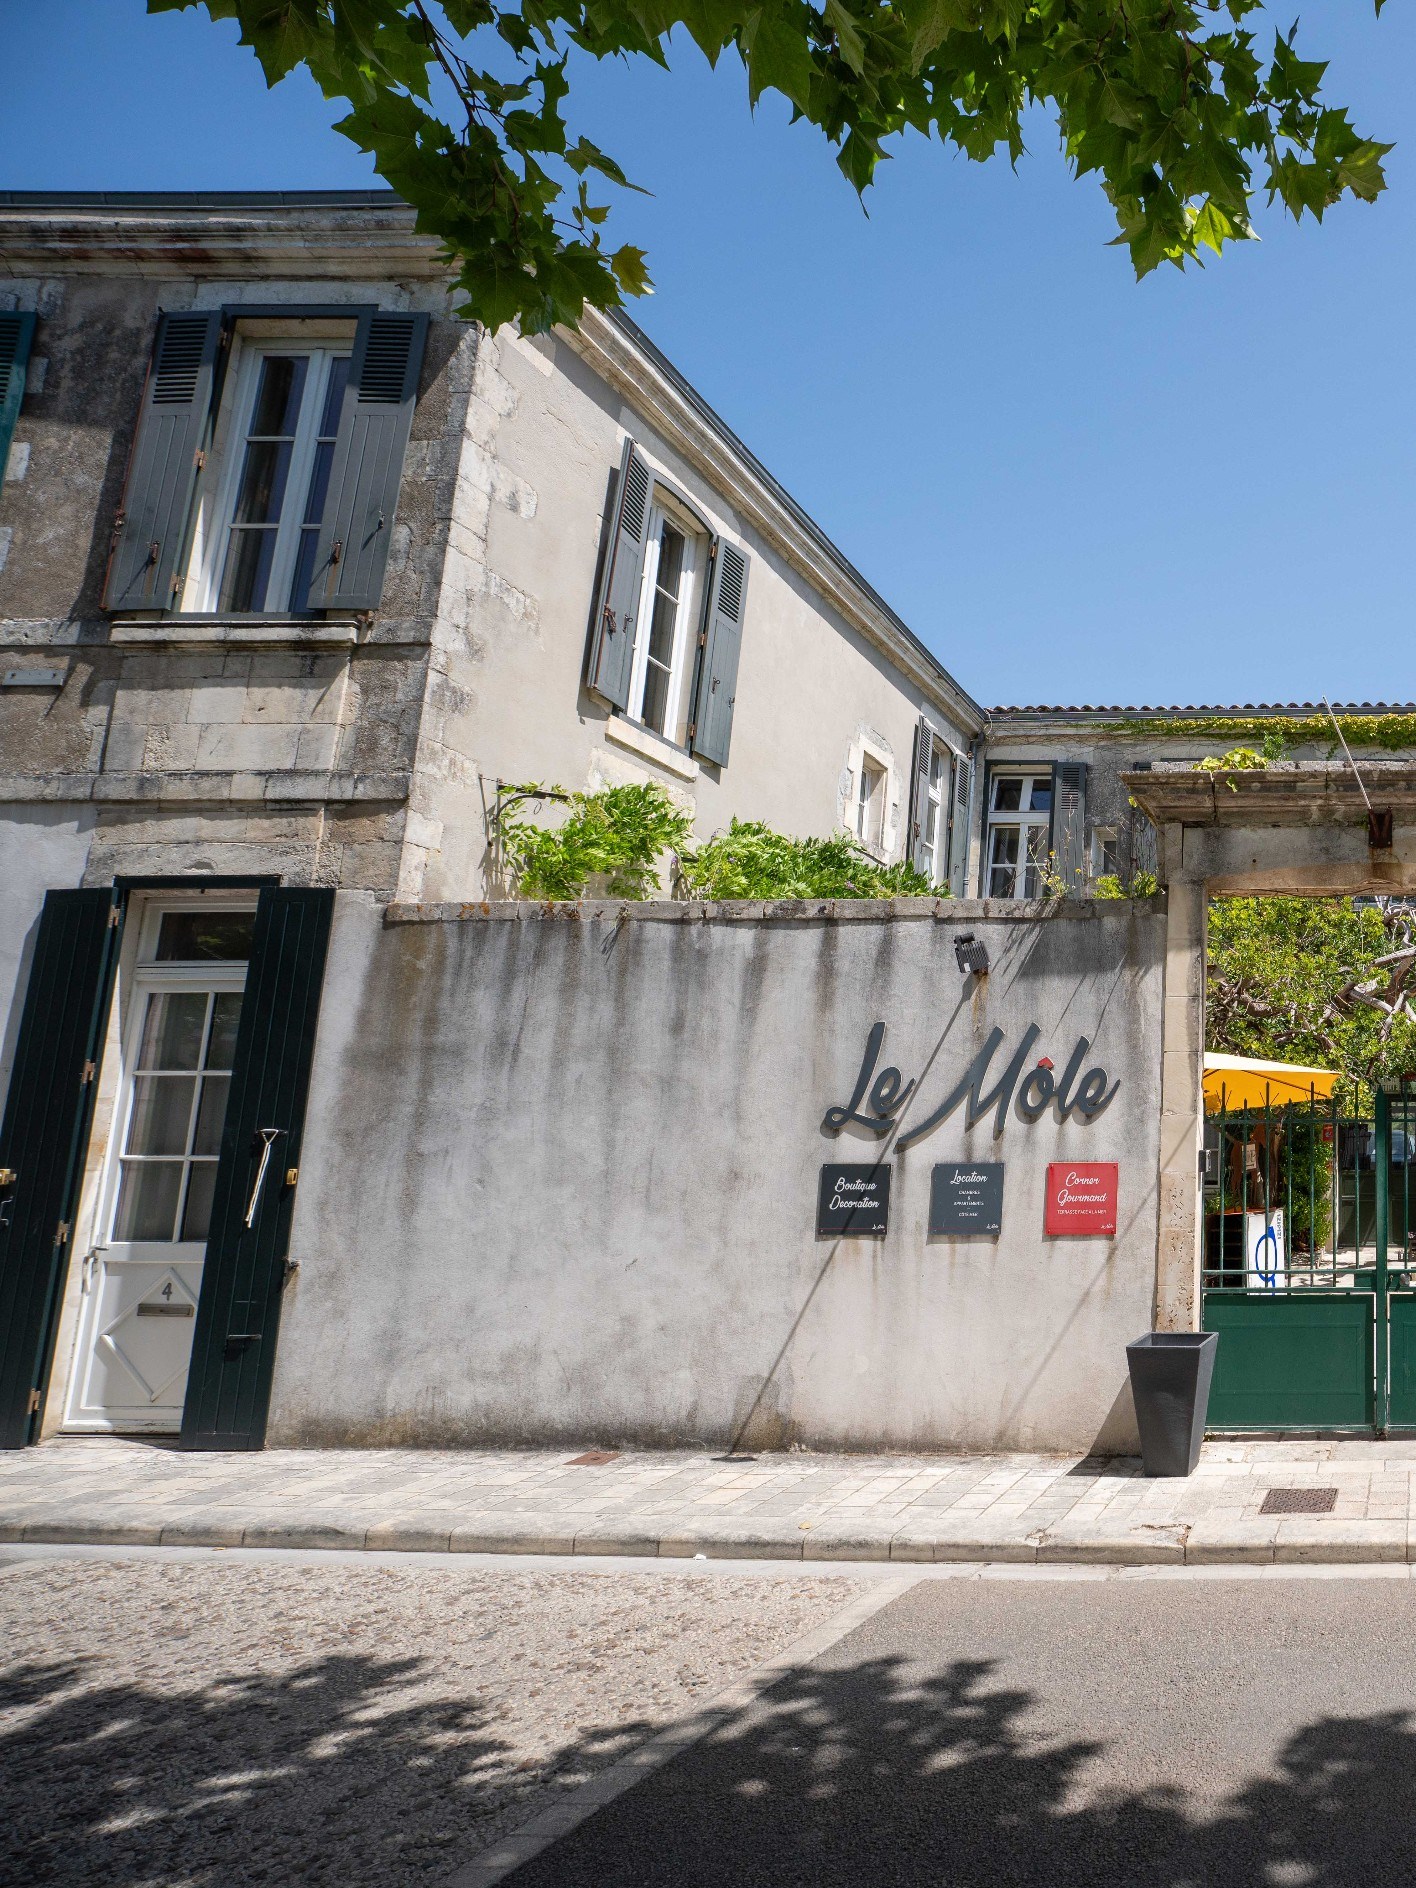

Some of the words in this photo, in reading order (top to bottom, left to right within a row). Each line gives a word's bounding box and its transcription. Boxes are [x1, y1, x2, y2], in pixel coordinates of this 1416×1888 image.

[824, 1021, 917, 1130] Le
[897, 1021, 1122, 1143] Môle
[835, 1177, 877, 1192] Boutique
[950, 1169, 988, 1184] Location
[1066, 1172, 1100, 1186] Corner
[1057, 1189, 1107, 1206] Gourmand
[161, 1282, 173, 1301] 4
